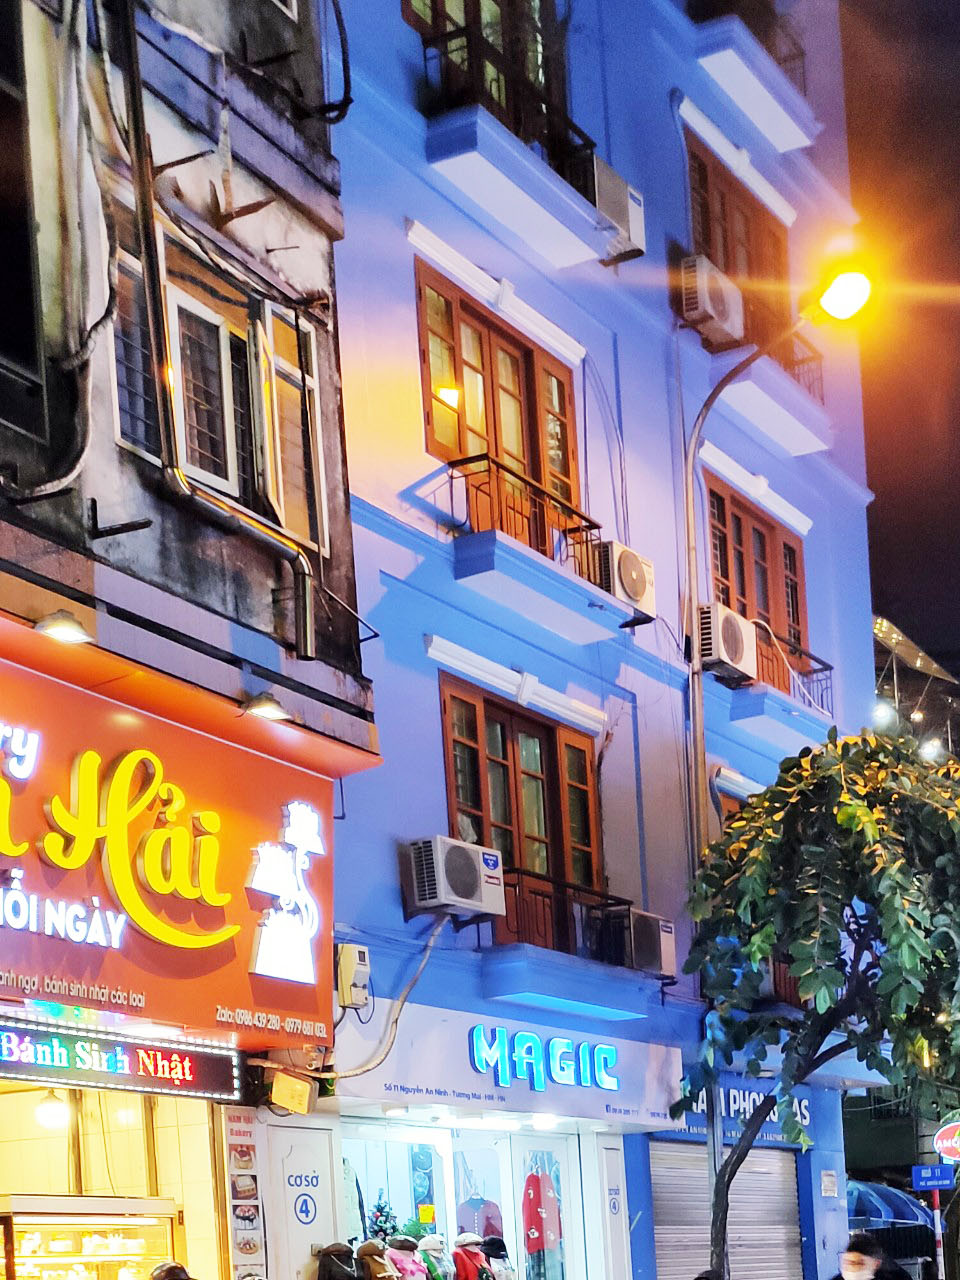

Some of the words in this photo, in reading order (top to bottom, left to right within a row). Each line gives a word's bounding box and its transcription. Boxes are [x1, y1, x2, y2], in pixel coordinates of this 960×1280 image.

[43, 749, 240, 948] Hải
[44, 896, 128, 949] NGÀY
[44, 975, 69, 995] bánh
[136, 1049, 193, 1085] Nhật
[468, 1024, 619, 1092] MAGIC
